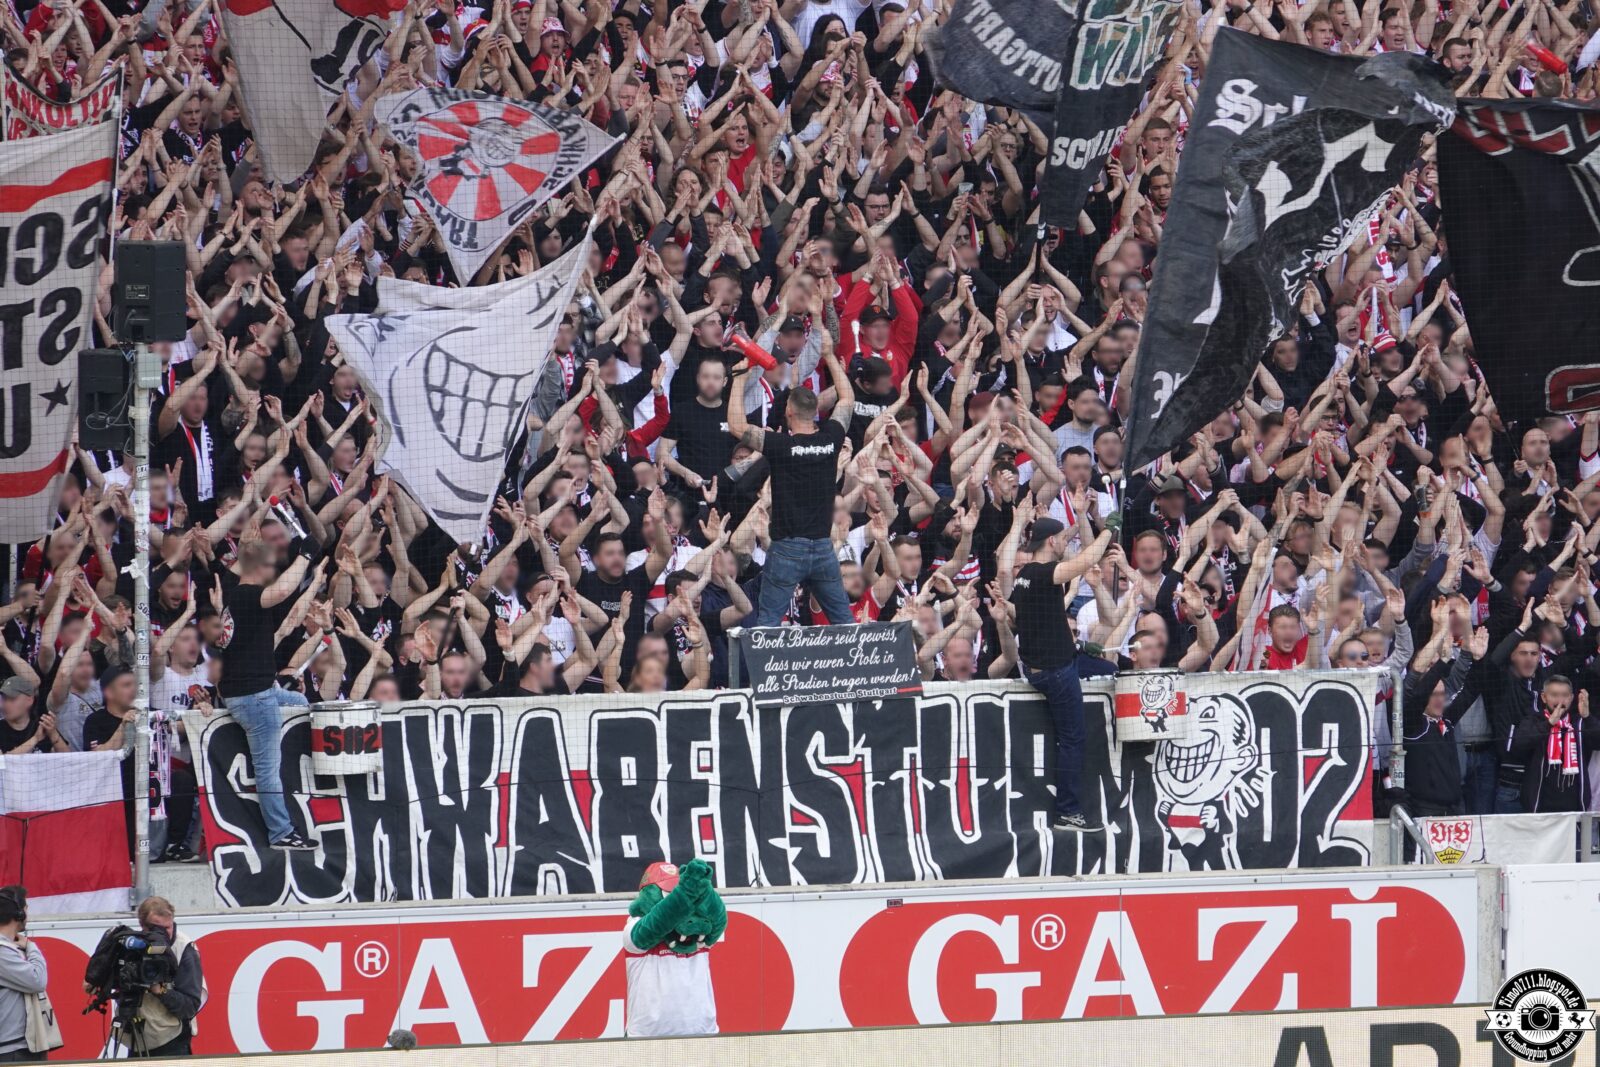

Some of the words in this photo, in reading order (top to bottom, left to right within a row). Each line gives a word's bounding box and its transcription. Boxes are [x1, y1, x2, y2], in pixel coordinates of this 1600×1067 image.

[752, 630, 785, 649] Doch
[787, 628, 832, 649] Brüder
[835, 626, 858, 645] seid
[859, 628, 898, 650] gewiss,
[764, 655, 789, 672] dass
[792, 658, 811, 671] wir
[813, 656, 845, 670] euren
[847, 647, 880, 668] Stolz
[882, 650, 895, 664] in
[757, 676, 780, 693] alle
[782, 673, 829, 692] Stadien
[832, 674, 870, 692] tragen
[871, 667, 915, 685] werden!
[783, 691, 856, 704] Schwabensturm
[857, 686, 898, 699] Stuttgart
